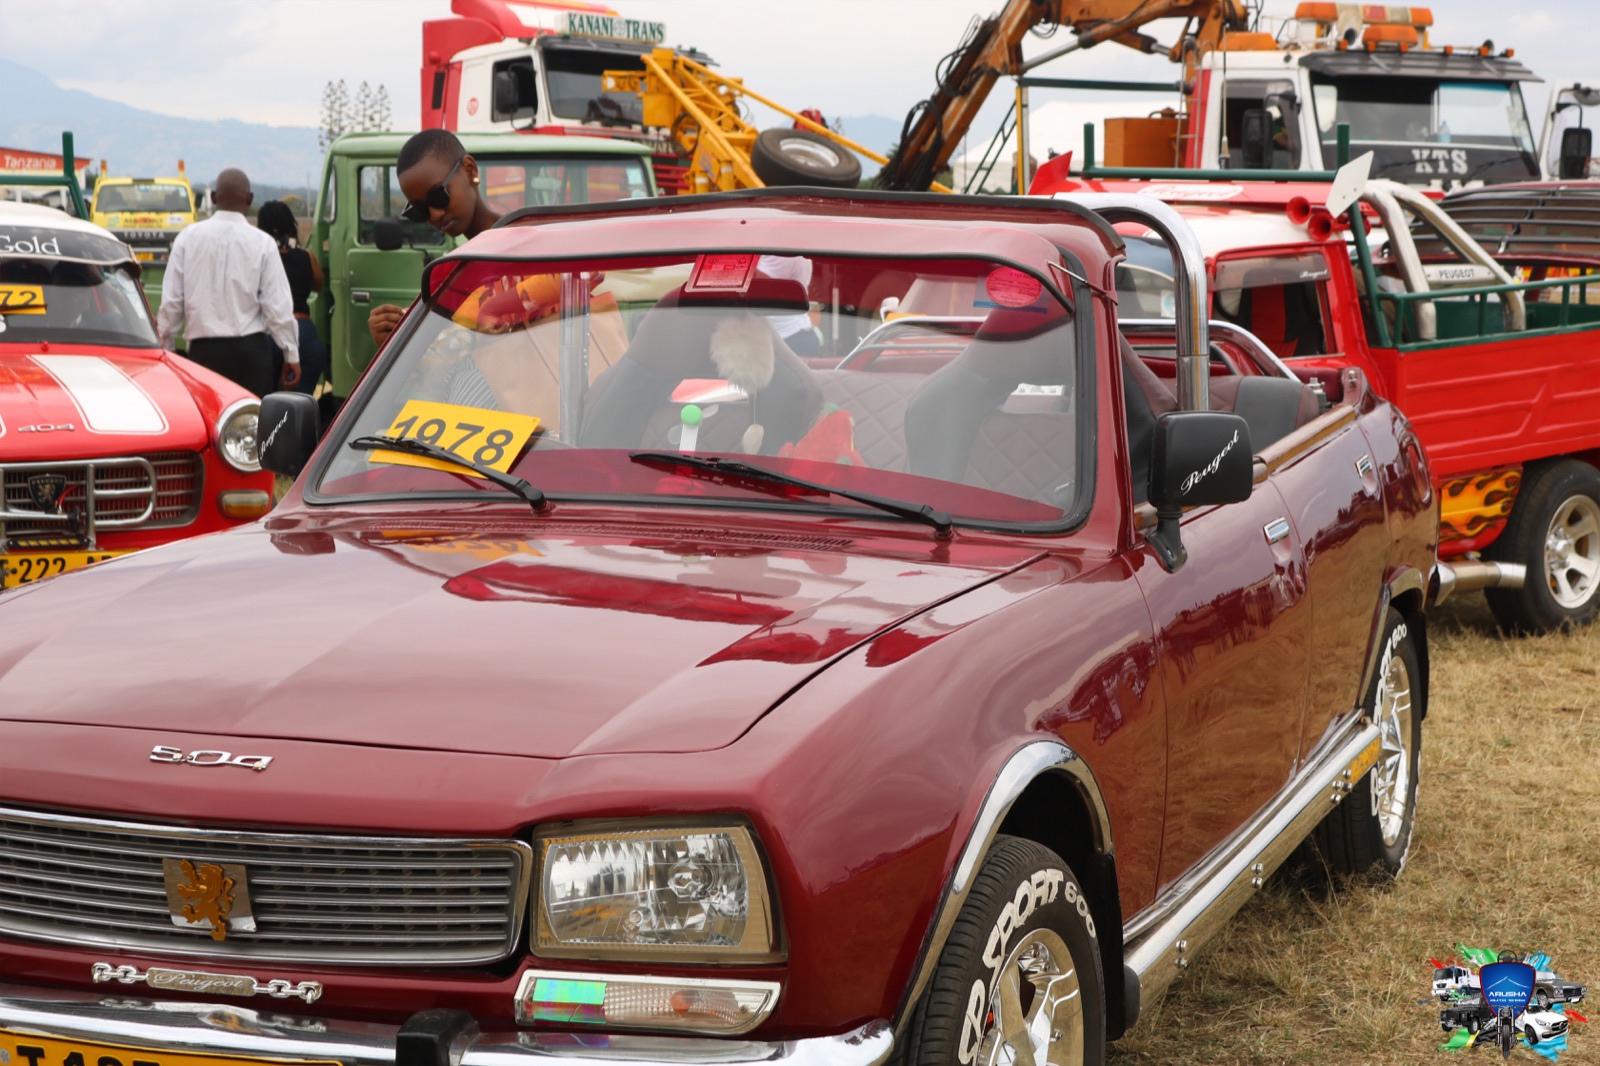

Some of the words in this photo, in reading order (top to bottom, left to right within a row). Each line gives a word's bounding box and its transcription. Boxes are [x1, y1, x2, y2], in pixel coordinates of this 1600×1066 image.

[568, 13, 614, 36] KANANI
[626, 20, 665, 42] TRANS
[4, 154, 57, 169] Tanzania
[1411, 148, 1469, 175] KTS
[0, 234, 62, 255] Gold
[123, 231, 165, 239] TOYOTA
[1439, 268, 1475, 279] PEUGEOT
[394, 415, 514, 467] 1978
[1181, 429, 1240, 496] Peugeot
[1064, 881, 1097, 938] 600
[152, 970, 244, 991] Peugeot
